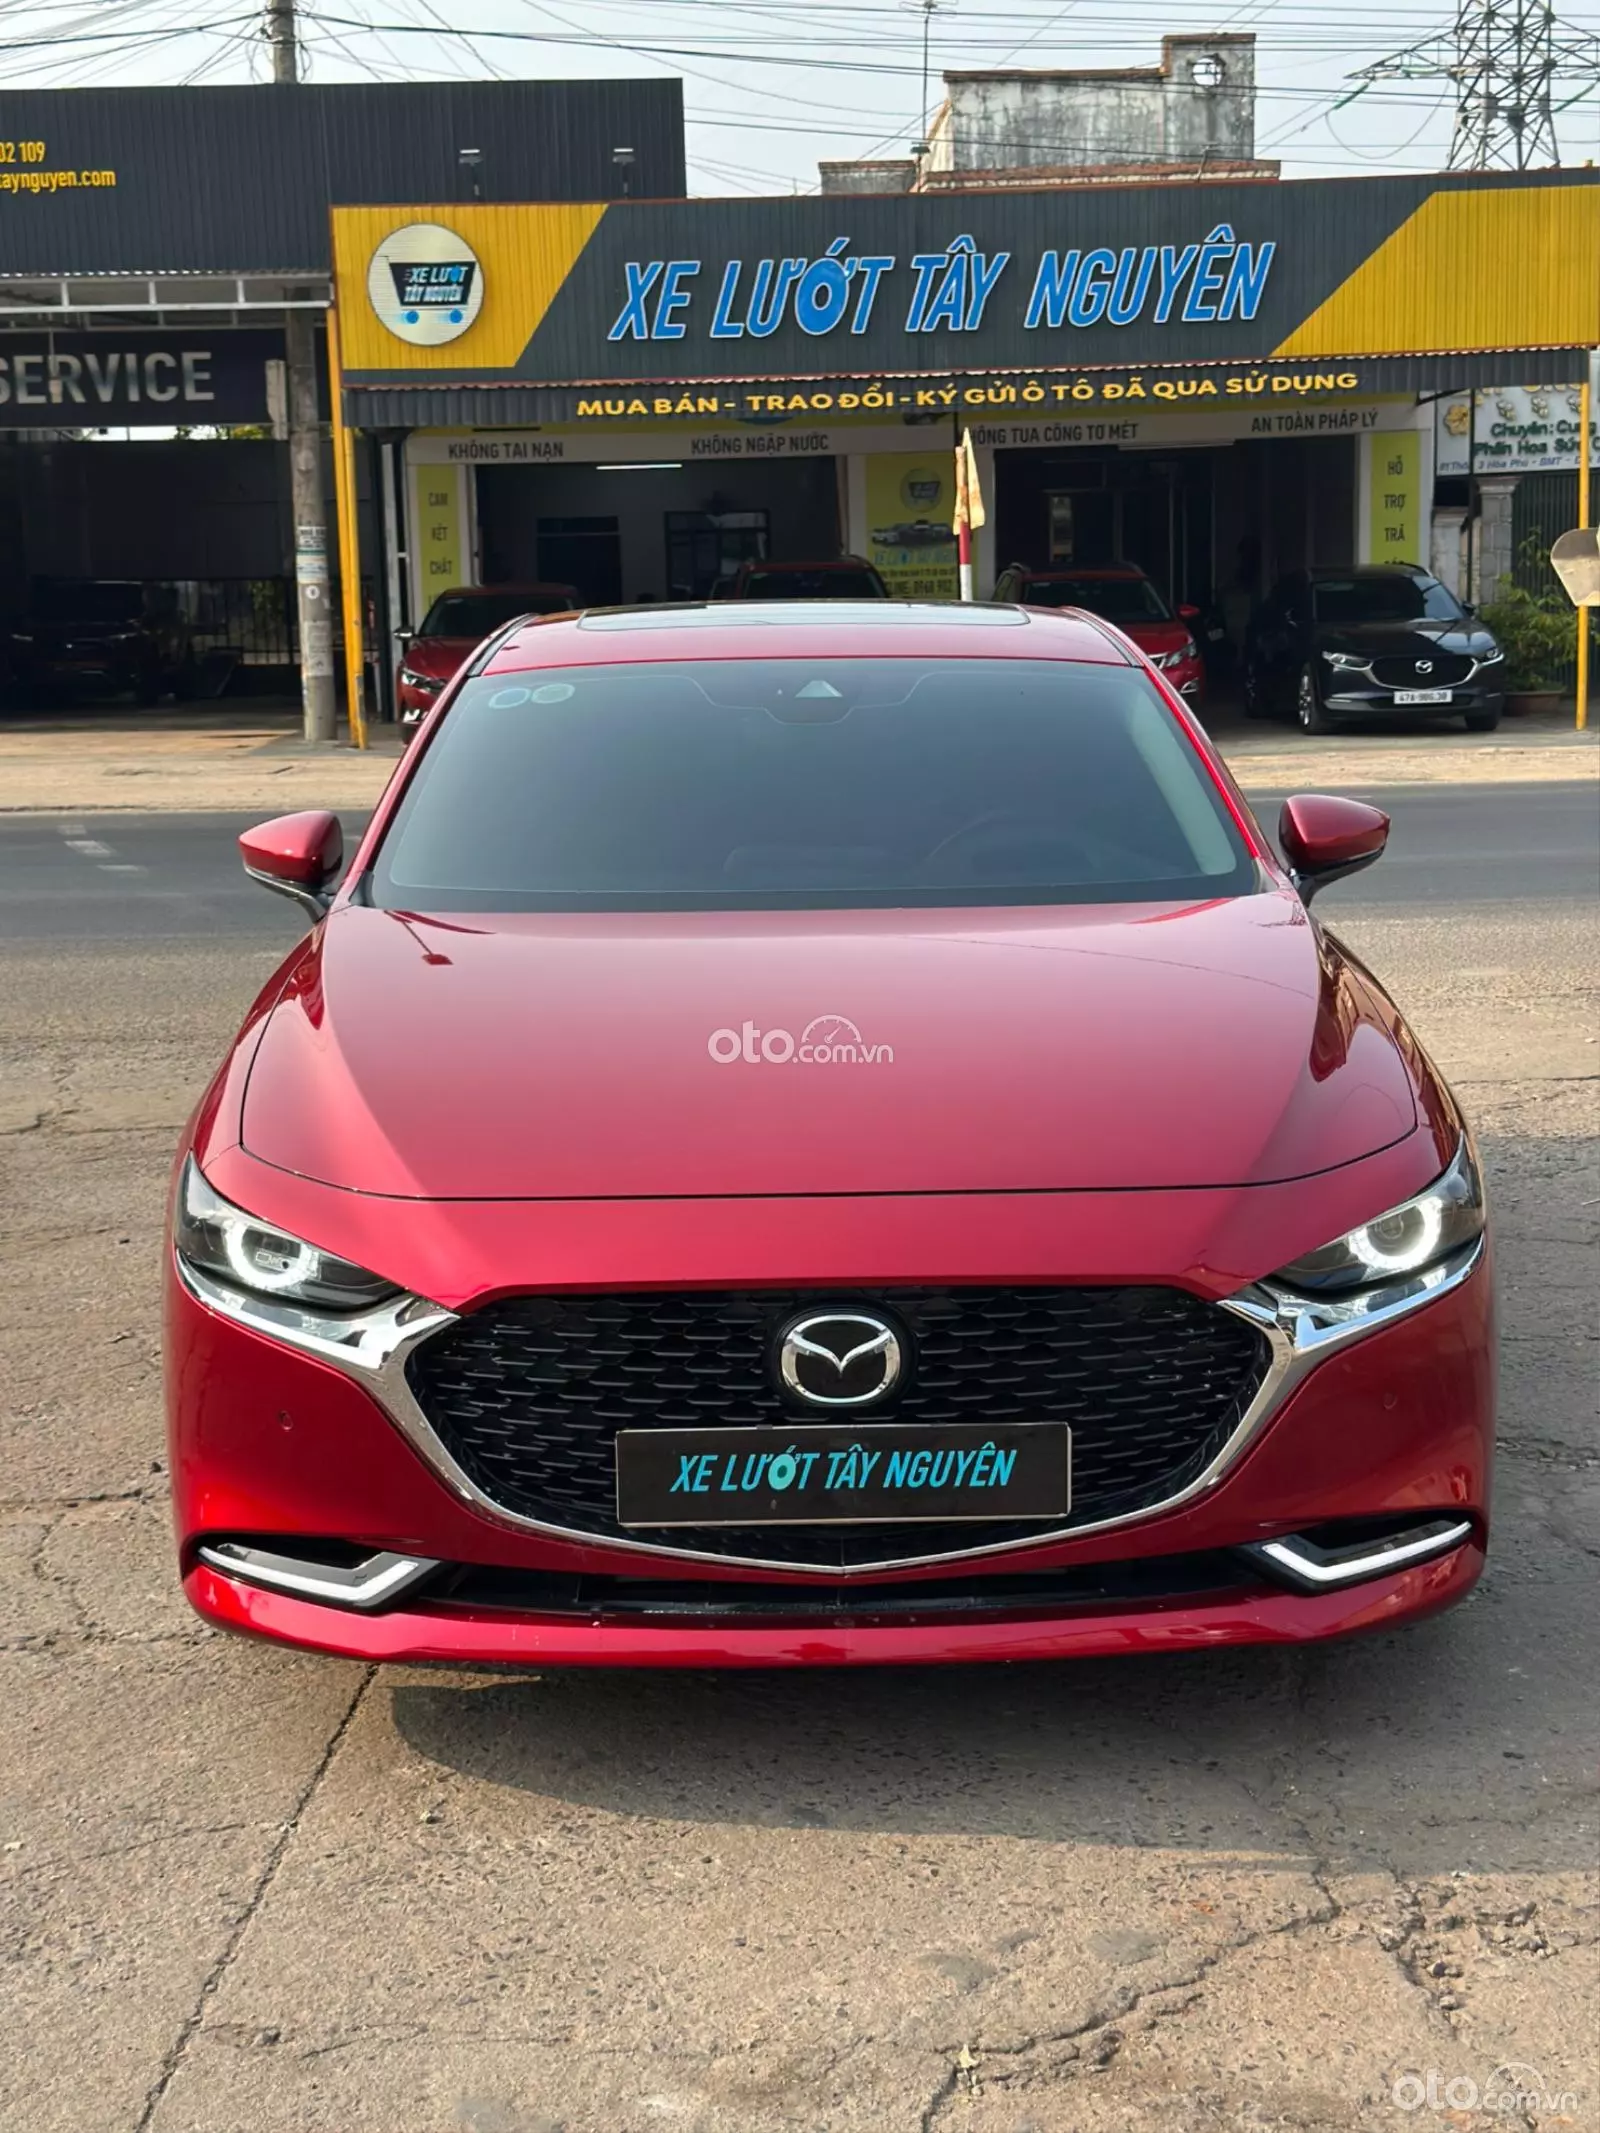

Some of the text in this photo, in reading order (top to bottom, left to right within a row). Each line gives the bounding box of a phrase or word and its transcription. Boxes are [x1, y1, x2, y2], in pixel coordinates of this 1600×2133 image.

[18, 141, 46, 163] 109
[409, 267, 430, 284] XE
[607, 223, 1276, 341] XE LƯỚT TÂY NGUYÊN
[577, 399, 649, 416] MUA
[653, 392, 718, 414] BÁN
[747, 394, 833, 411] TRAO
[838, 384, 894, 408] ĐỔI
[917, 384, 957, 406] KÝ
[964, 380, 1016, 404] GỬI
[1021, 380, 1044, 400] Ô
[1051, 379, 1094, 400] TÔ
[1102, 377, 1146, 399] ĐÃ
[1151, 379, 1217, 401] QUA
[1225, 370, 1268, 395] SỬ
[1278, 373, 1359, 396] DỤNG
[1252, 407, 1379, 432] AN TOÀN PHÁP LÝ
[691, 434, 742, 455] KHÔNG
[970, 424, 1007, 445] HÔNG
[1012, 427, 1040, 443] TUA
[1044, 424, 1082, 442] CÔNG
[1109, 420, 1139, 440] MÉT
[448, 441, 564, 461] KHÔNG TAI NẠN
[670, 1441, 1017, 1493] XE LƯỚT TÂY NGUYÊN
